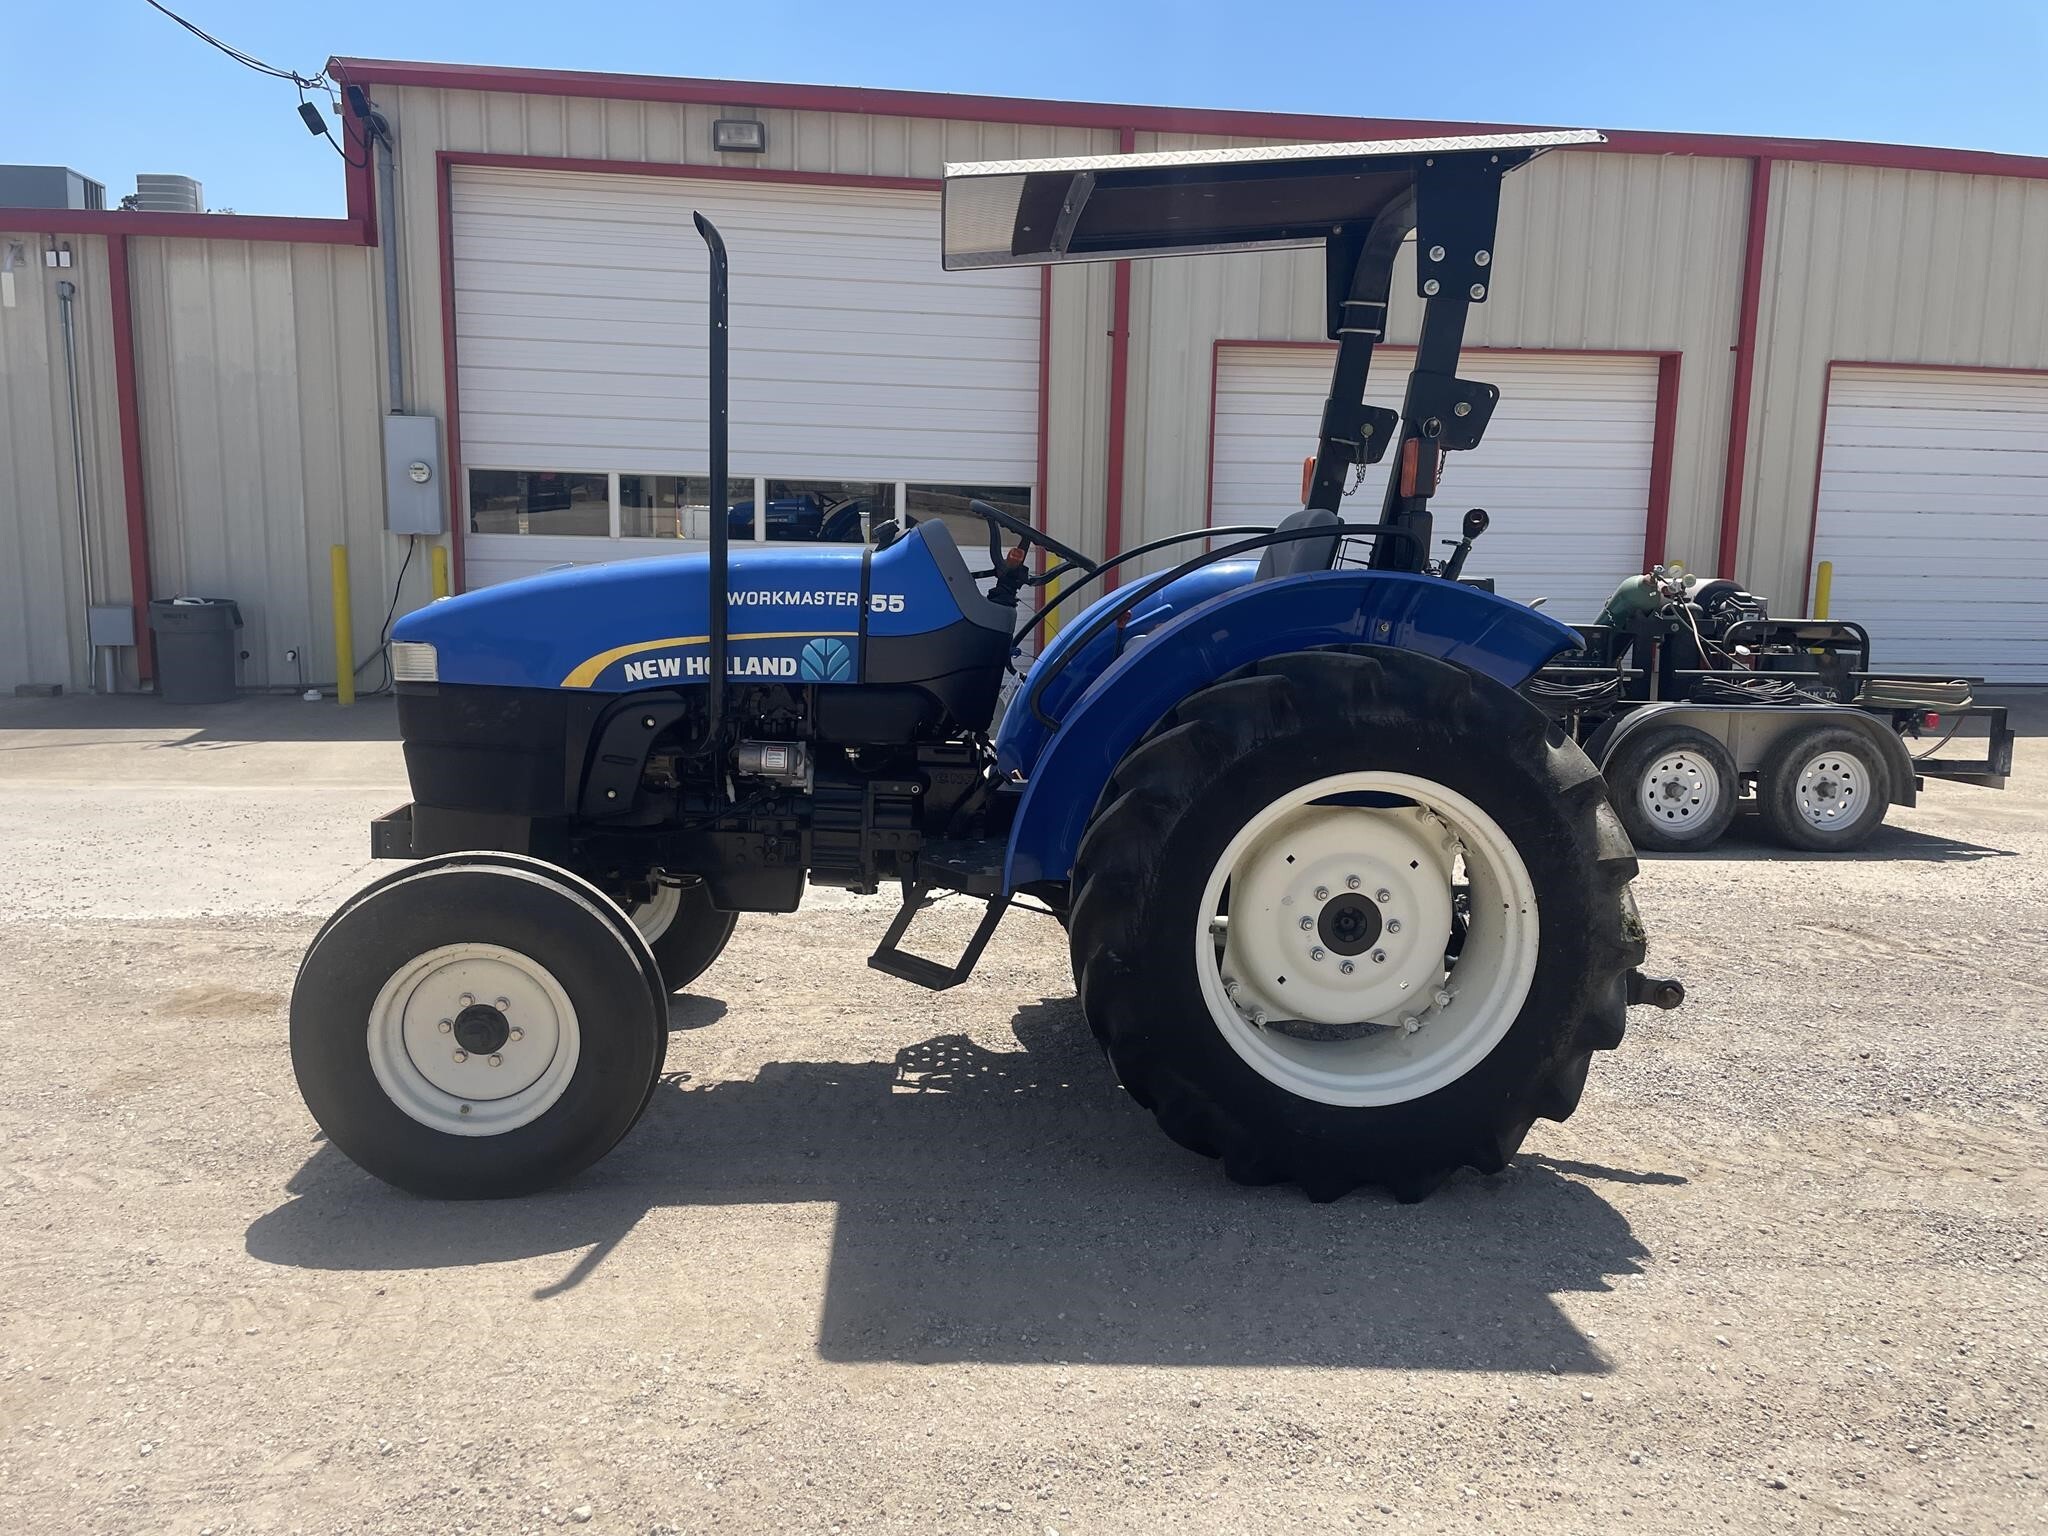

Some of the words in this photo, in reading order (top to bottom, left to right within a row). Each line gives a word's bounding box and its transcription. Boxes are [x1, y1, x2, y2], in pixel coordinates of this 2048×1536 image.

[727, 591, 859, 606] WORKMASTER
[870, 594, 905, 613] 55
[624, 657, 681, 683] NEW
